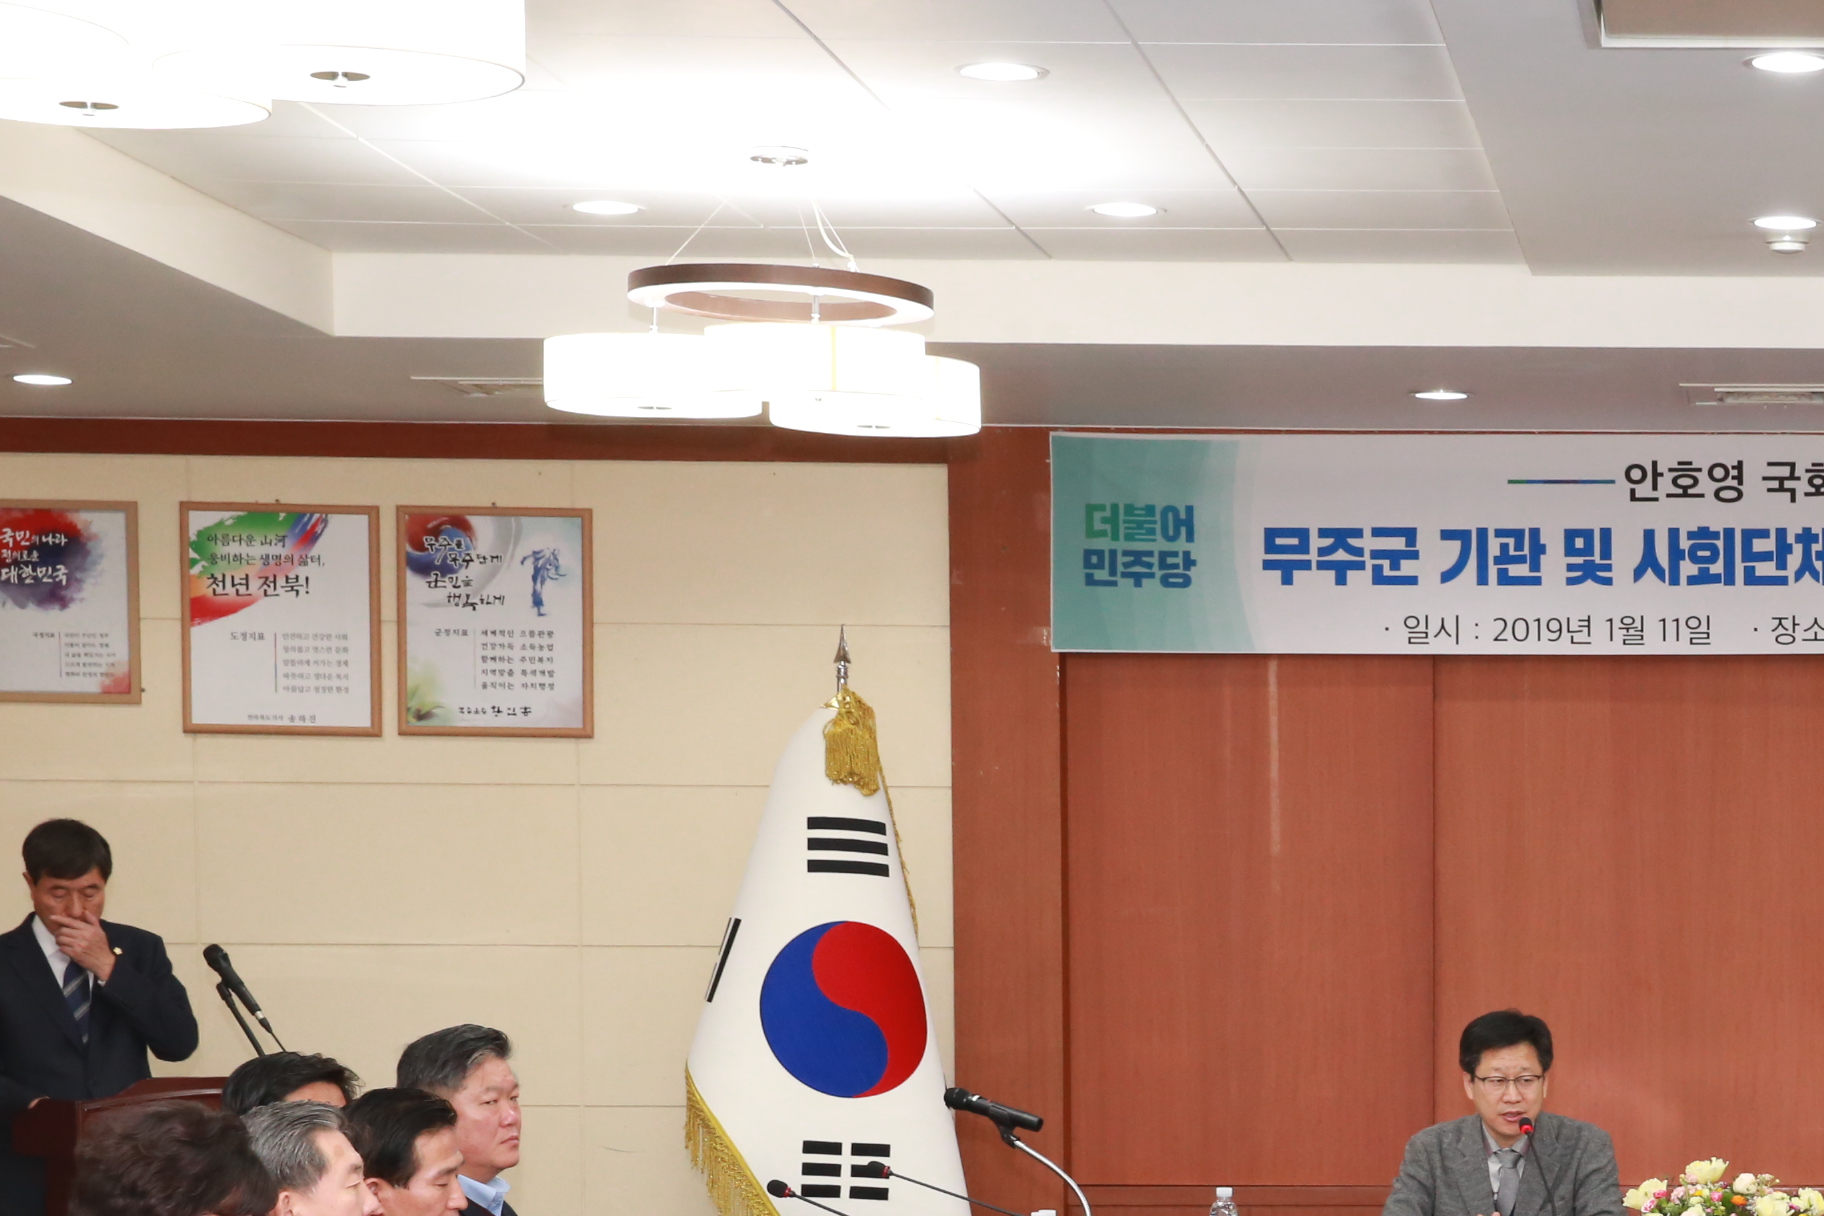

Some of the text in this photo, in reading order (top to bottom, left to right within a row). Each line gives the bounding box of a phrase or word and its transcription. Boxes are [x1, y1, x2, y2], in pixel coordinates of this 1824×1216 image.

[1624, 460, 1745, 503] 안호영
[1084, 503, 1195, 544] 더불어
[207, 533, 287, 548] 아름다운 山河
[208, 553, 256, 566] 웅비하는
[260, 554, 294, 567] 생명의
[1082, 548, 1197, 589] 민주당
[1262, 526, 1419, 587] 무주군
[1439, 526, 1546, 587] 기관
[1563, 526, 1614, 587] 및
[1, 564, 68, 585] 대한민국
[206, 573, 310, 598] 천년 전북!
[1492, 615, 1593, 646] 2019년
[1605, 615, 1646, 645] 1월
[1658, 615, 1712, 645] 11일
